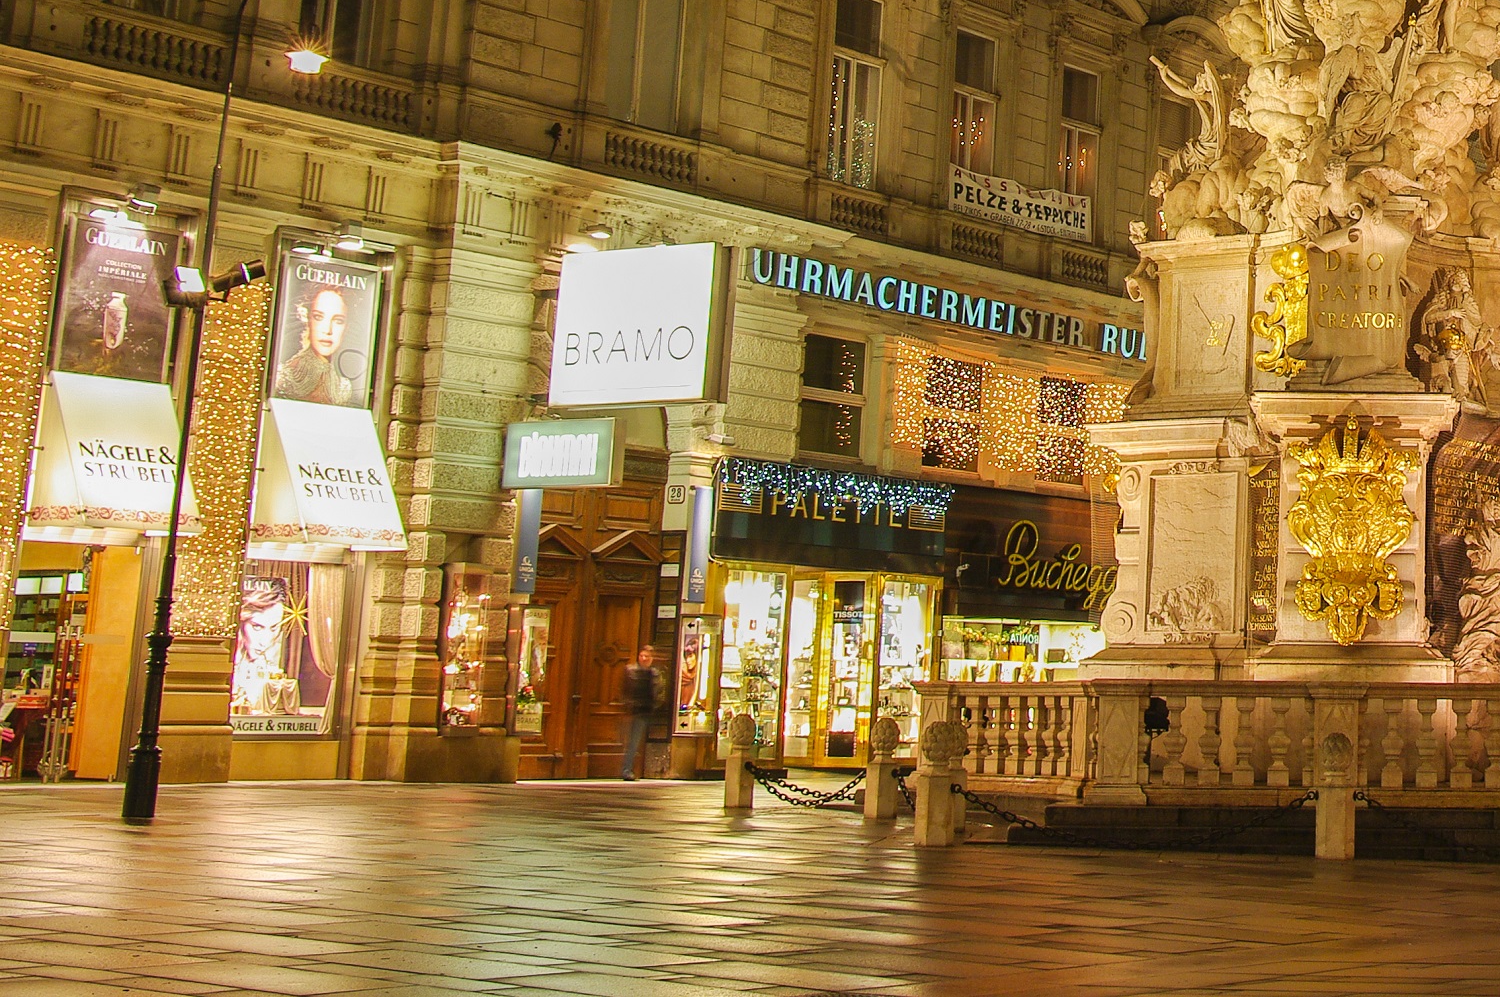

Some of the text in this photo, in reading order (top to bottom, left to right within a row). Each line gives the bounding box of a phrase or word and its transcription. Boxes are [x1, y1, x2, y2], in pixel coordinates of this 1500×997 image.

[954, 182, 1086, 229] PELZE & TEPPICHE
[990, 212, 1015, 225] GRABEN
[85, 227, 168, 256] GUERLAIN
[1325, 250, 1385, 272] DEO
[296, 264, 368, 291] GUERLAIN
[752, 247, 1090, 349] UHRMACHERMEISTER
[1318, 284, 1392, 302] PATRI
[565, 325, 695, 367] BRAMO
[78, 439, 178, 465] NÄGELE &
[298, 462, 384, 486] NÄGELE &
[303, 482, 389, 504] STRUBELL
[770, 487, 903, 529] PALETTE
[833, 610, 864, 619] TISSOT
[265, 719, 275, 732] &
[276, 721, 319, 733] STRUBELL
